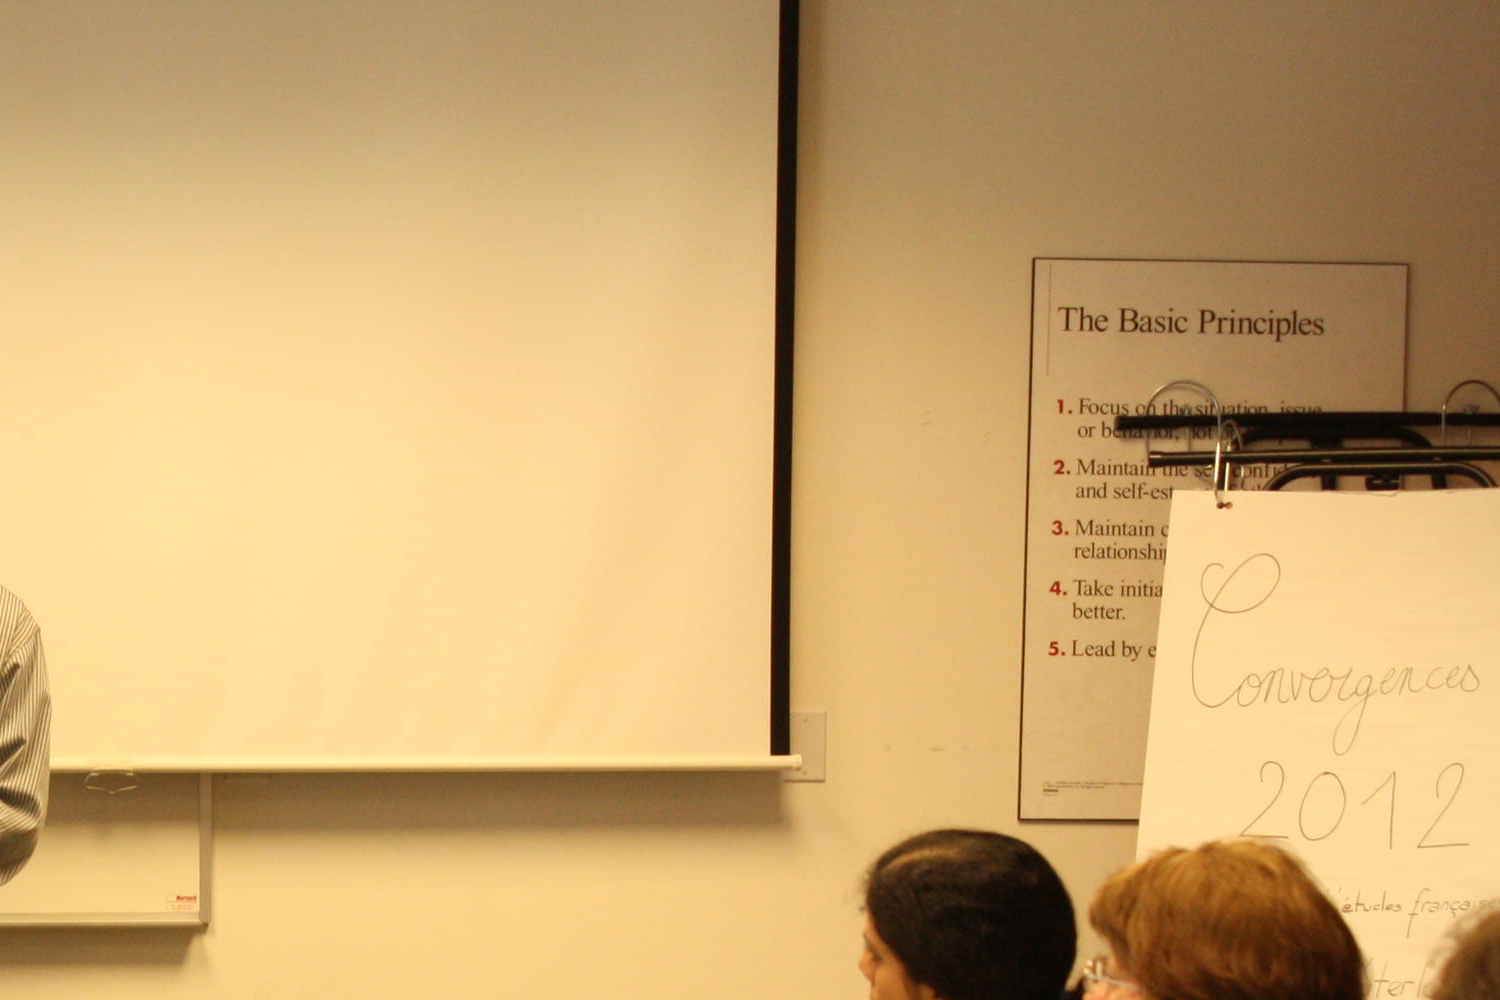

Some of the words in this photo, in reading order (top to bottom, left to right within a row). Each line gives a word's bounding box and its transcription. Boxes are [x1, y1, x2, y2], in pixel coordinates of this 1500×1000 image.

[1057, 305, 1109, 334] The
[1117, 307, 1189, 335] Basic
[1198, 308, 1326, 343] Principles
[1057, 399, 1074, 415] 1.
[1078, 398, 1130, 416] Focus
[1077, 425, 1096, 438] or
[1053, 459, 1071, 476] 2.
[1076, 458, 1156, 477] Maintain
[1076, 482, 1108, 499] and
[1113, 482, 1173, 499] self-est
[1051, 520, 1070, 536] 3.
[1075, 518, 1156, 537] Maintain
[1049, 580, 1068, 597] 4.
[1073, 579, 1114, 597] Take
[1120, 579, 1163, 598] initia
[1071, 602, 1126, 620] better.
[1048, 641, 1067, 657] 5.
[1071, 640, 1116, 657] Lead
[1122, 640, 1143, 663] by
[1238, 760, 1470, 851] 2012
